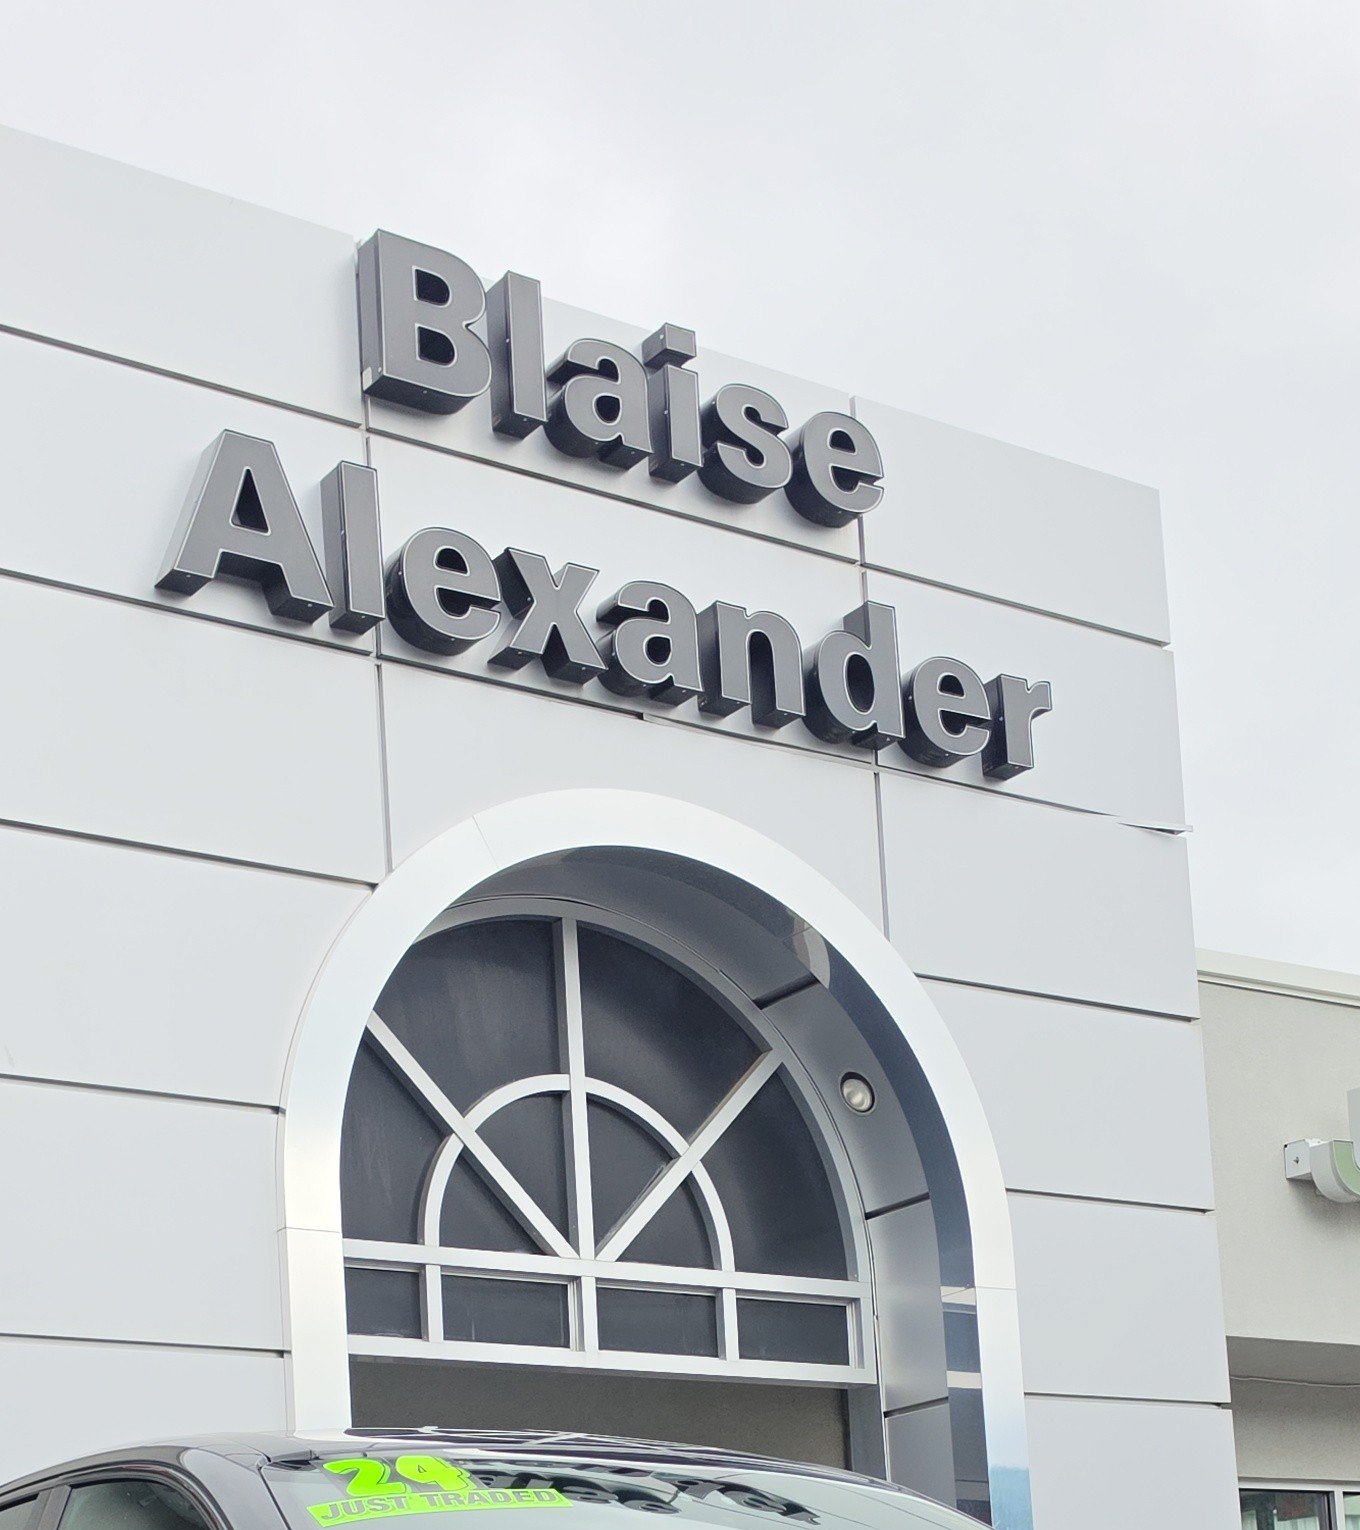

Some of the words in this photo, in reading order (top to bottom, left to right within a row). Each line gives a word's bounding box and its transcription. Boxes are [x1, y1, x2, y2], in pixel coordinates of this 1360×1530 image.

[358, 229, 883, 528] Blaise
[156, 429, 1051, 779] Alexander
[321, 1496, 407, 1520] JUST
[418, 1489, 561, 1507] TRADED
[323, 1455, 474, 1496] 24
